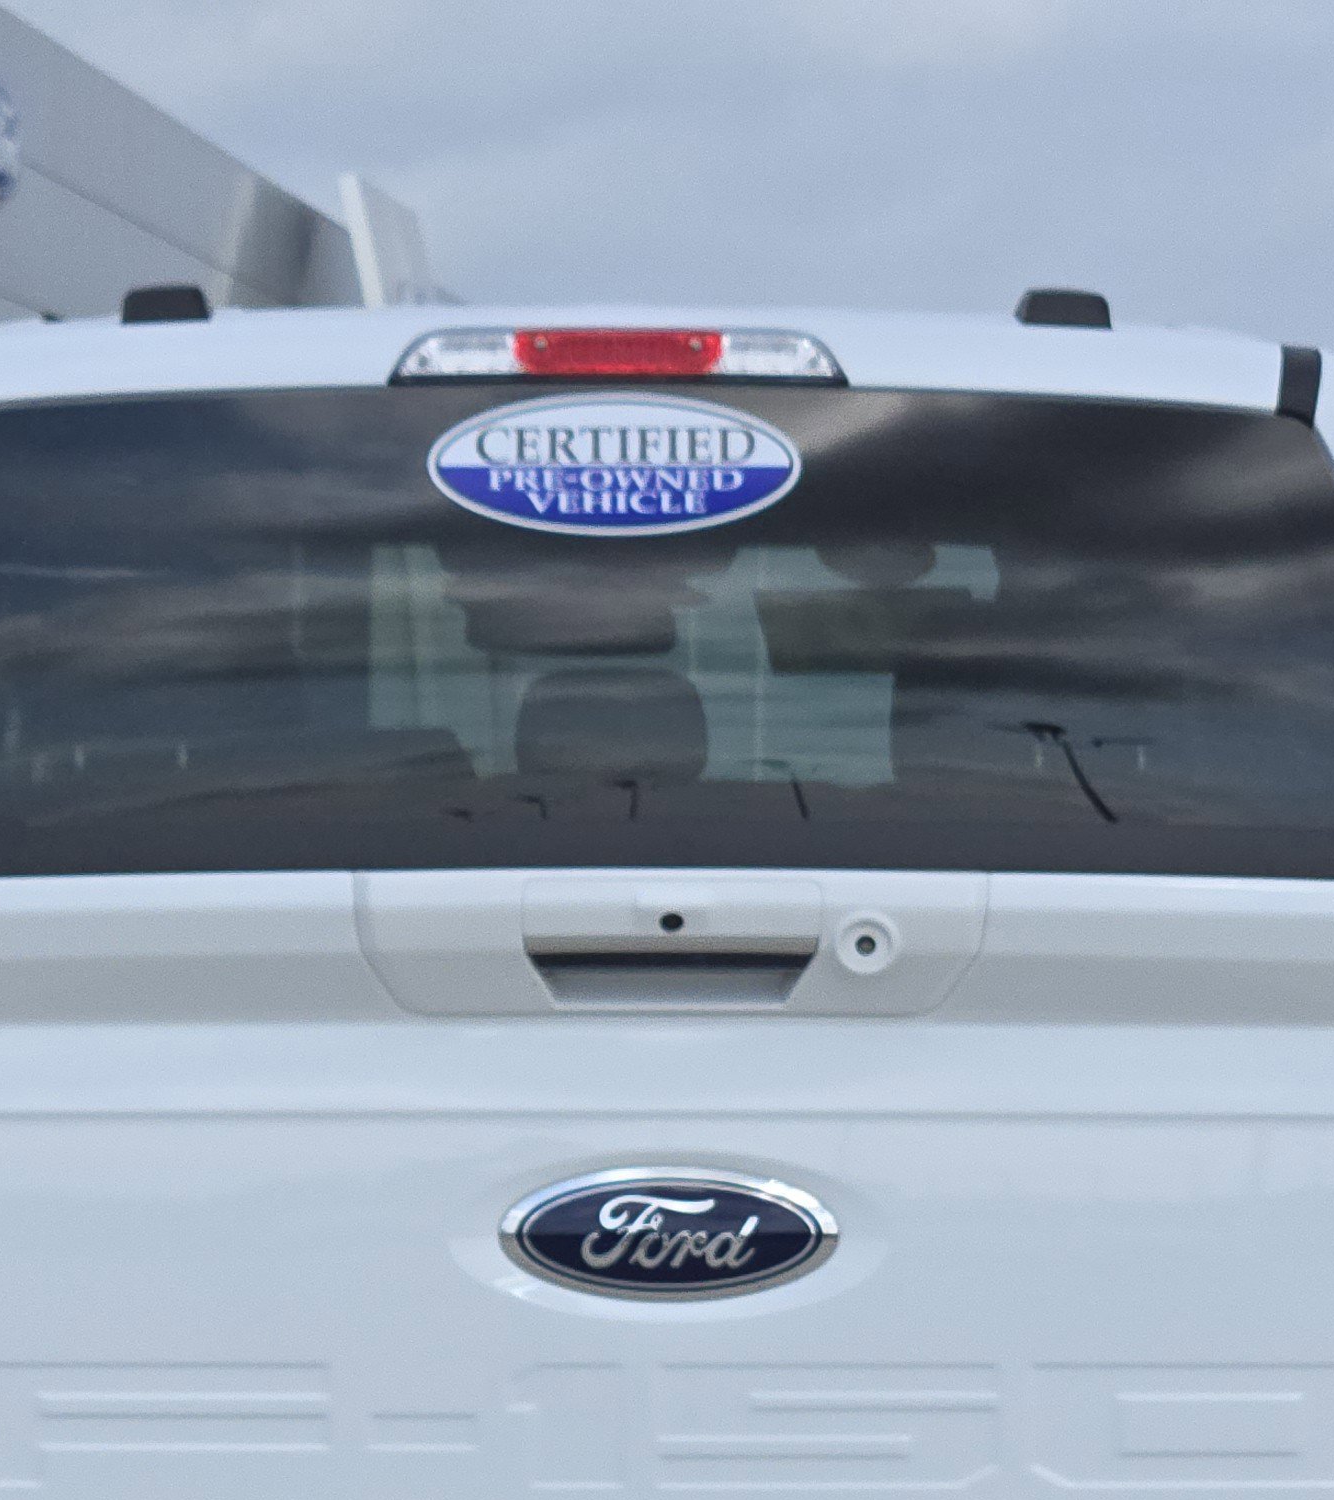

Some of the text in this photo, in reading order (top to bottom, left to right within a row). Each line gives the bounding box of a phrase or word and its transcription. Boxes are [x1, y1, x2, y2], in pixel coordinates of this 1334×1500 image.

[475, 425, 757, 466] CERTIFIED
[488, 466, 744, 492] PRE-OWNED
[526, 491, 708, 515] VEHICLE
[581, 1195, 759, 1269] Ford
